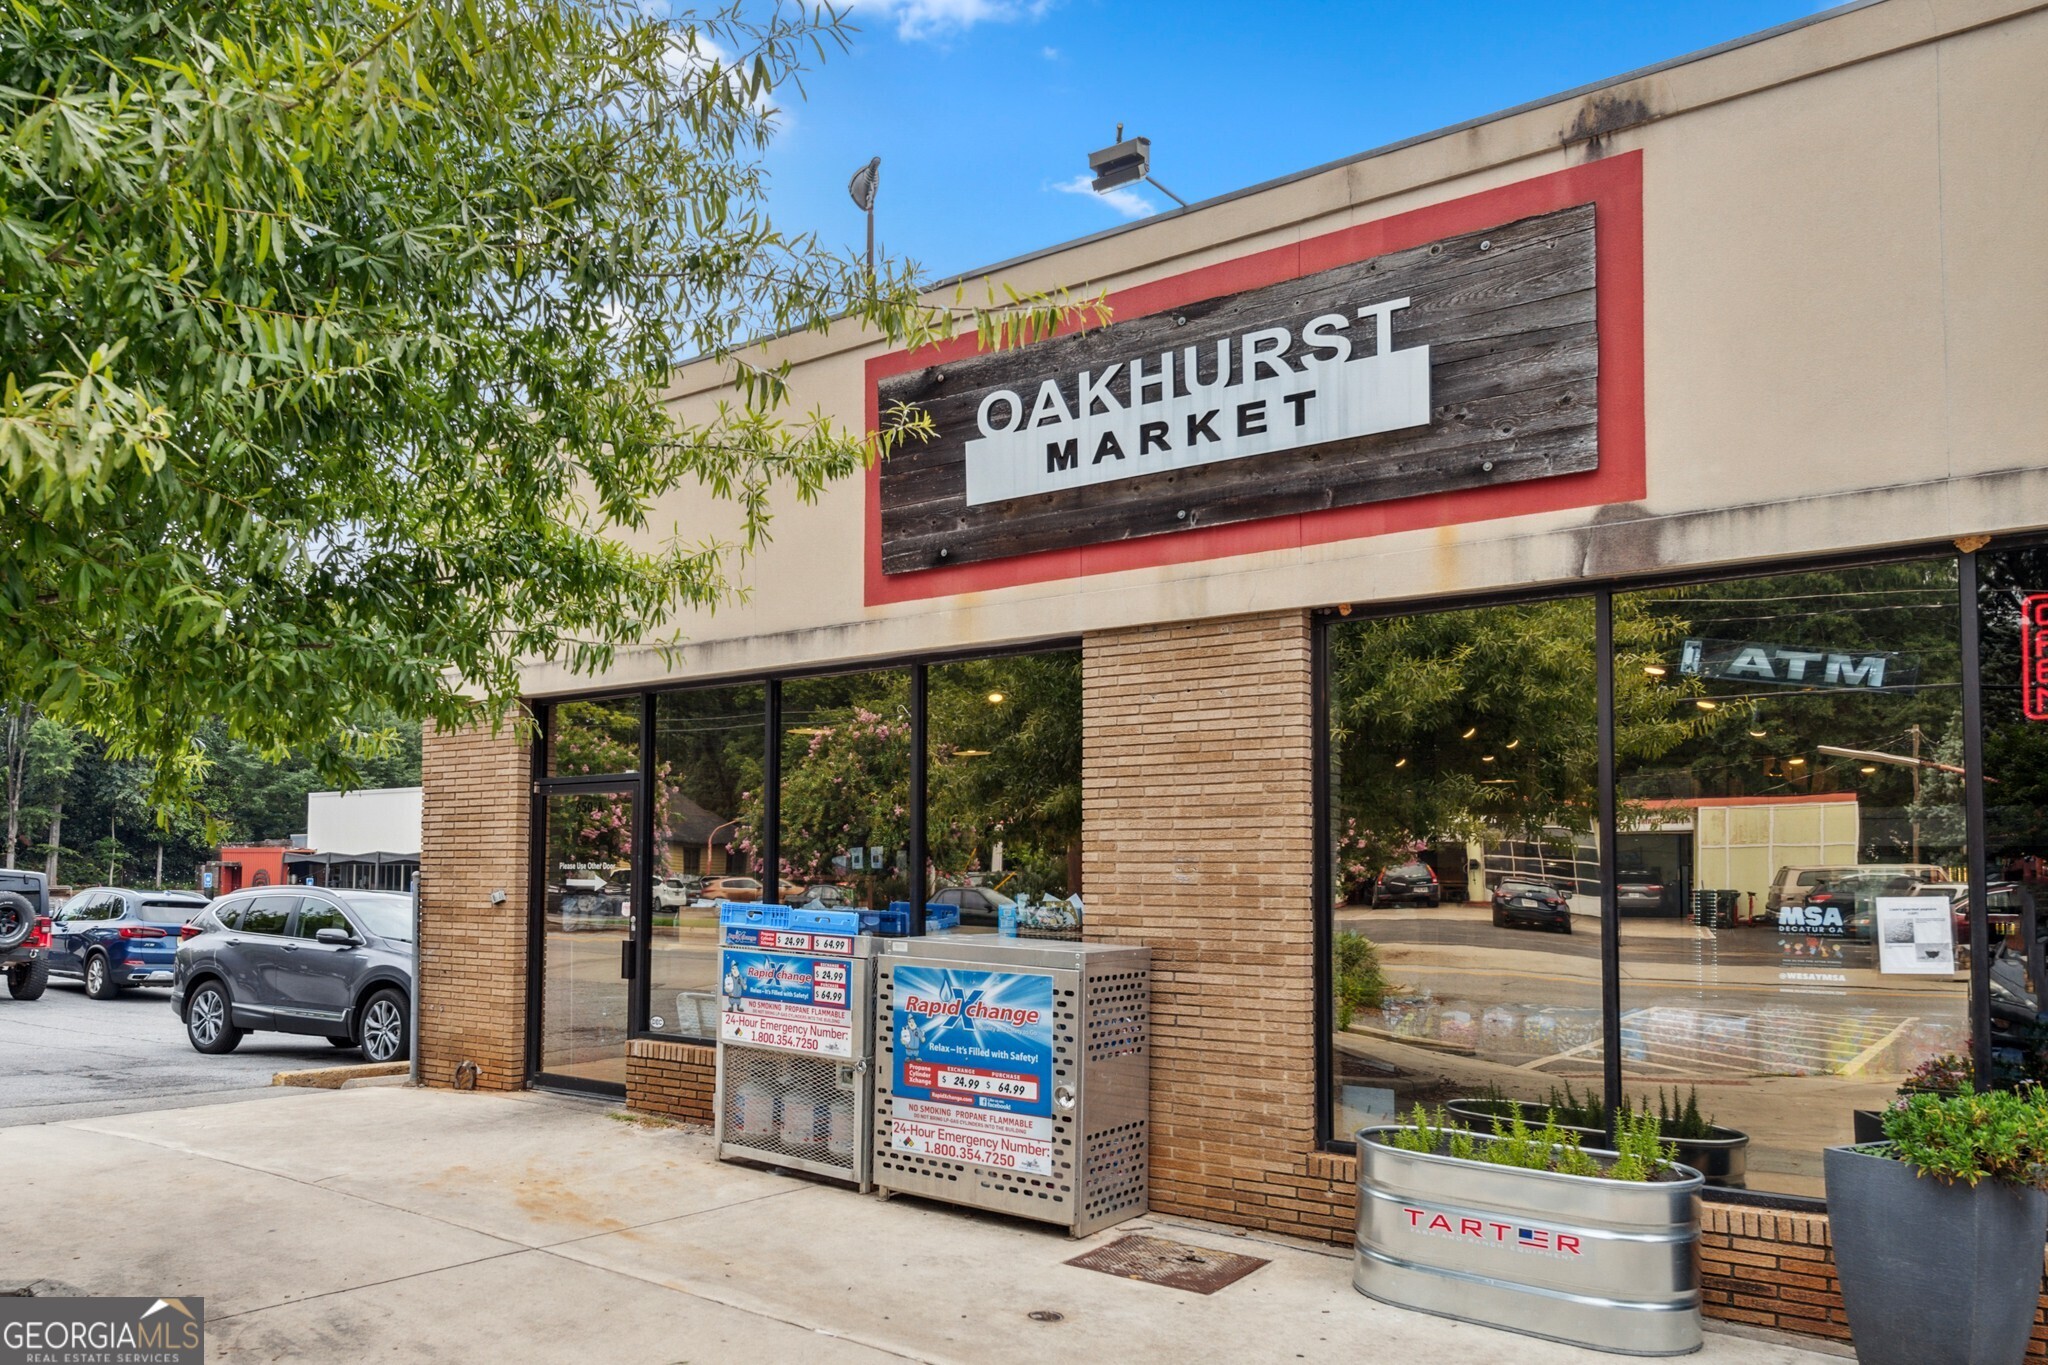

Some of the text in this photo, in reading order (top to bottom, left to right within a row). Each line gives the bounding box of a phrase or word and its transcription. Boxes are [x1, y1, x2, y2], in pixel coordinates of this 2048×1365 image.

[976, 296, 1411, 440] OAKHURST
[1046, 389, 1318, 474] MARKET
[1725, 647, 1886, 687] ATM
[559, 862, 576, 870] Please
[576, 862, 587, 870] Use
[588, 862, 602, 870] Other
[1778, 906, 1844, 926] MSA
[784, 937, 805, 947] 24.99
[823, 939, 845, 950] 64.99
[822, 970, 844, 981] 24.99
[1778, 972, 1846, 982] @WESAYMSA
[821, 991, 843, 1002] 64.99
[756, 1002, 782, 1011] SMOKING
[785, 1004, 810, 1015] PROPANE
[811, 1008, 845, 1019] FLAMMABLE
[725, 1014, 849, 1041] 24-Hour Emergency Number:
[751, 1030, 819, 1050] 1.800.354.7250
[929, 1042, 950, 1053] Relax
[968, 1046, 990, 1058] Filled
[991, 1049, 1009, 1060] with
[1009, 1052, 1039, 1064] Safety!
[908, 1063, 932, 1073] Propane
[908, 1070, 931, 1080] Cylinder
[947, 1066, 1021, 1081] EXCHANGE PURCHASE
[908, 1076, 932, 1086] Xchange
[941, 1076, 1025, 1096] $ 24.99 $ 64.99
[908, 1103, 1033, 1129] NO SMOKING PROPANE FLAMMABLE
[959, 1119, 984, 1128] CYLINDERS
[984, 1122, 995, 1130] INTO
[1005, 1126, 1027, 1135] BUILDING
[893, 1121, 1050, 1158] 24-Hour Emergency Number:
[924, 1141, 1015, 1167] 1.800.354.7250
[1404, 1208, 1582, 1255] TARTER
[1410, 1227, 1576, 1261] FARM AND RANCH EQUIPMENT
